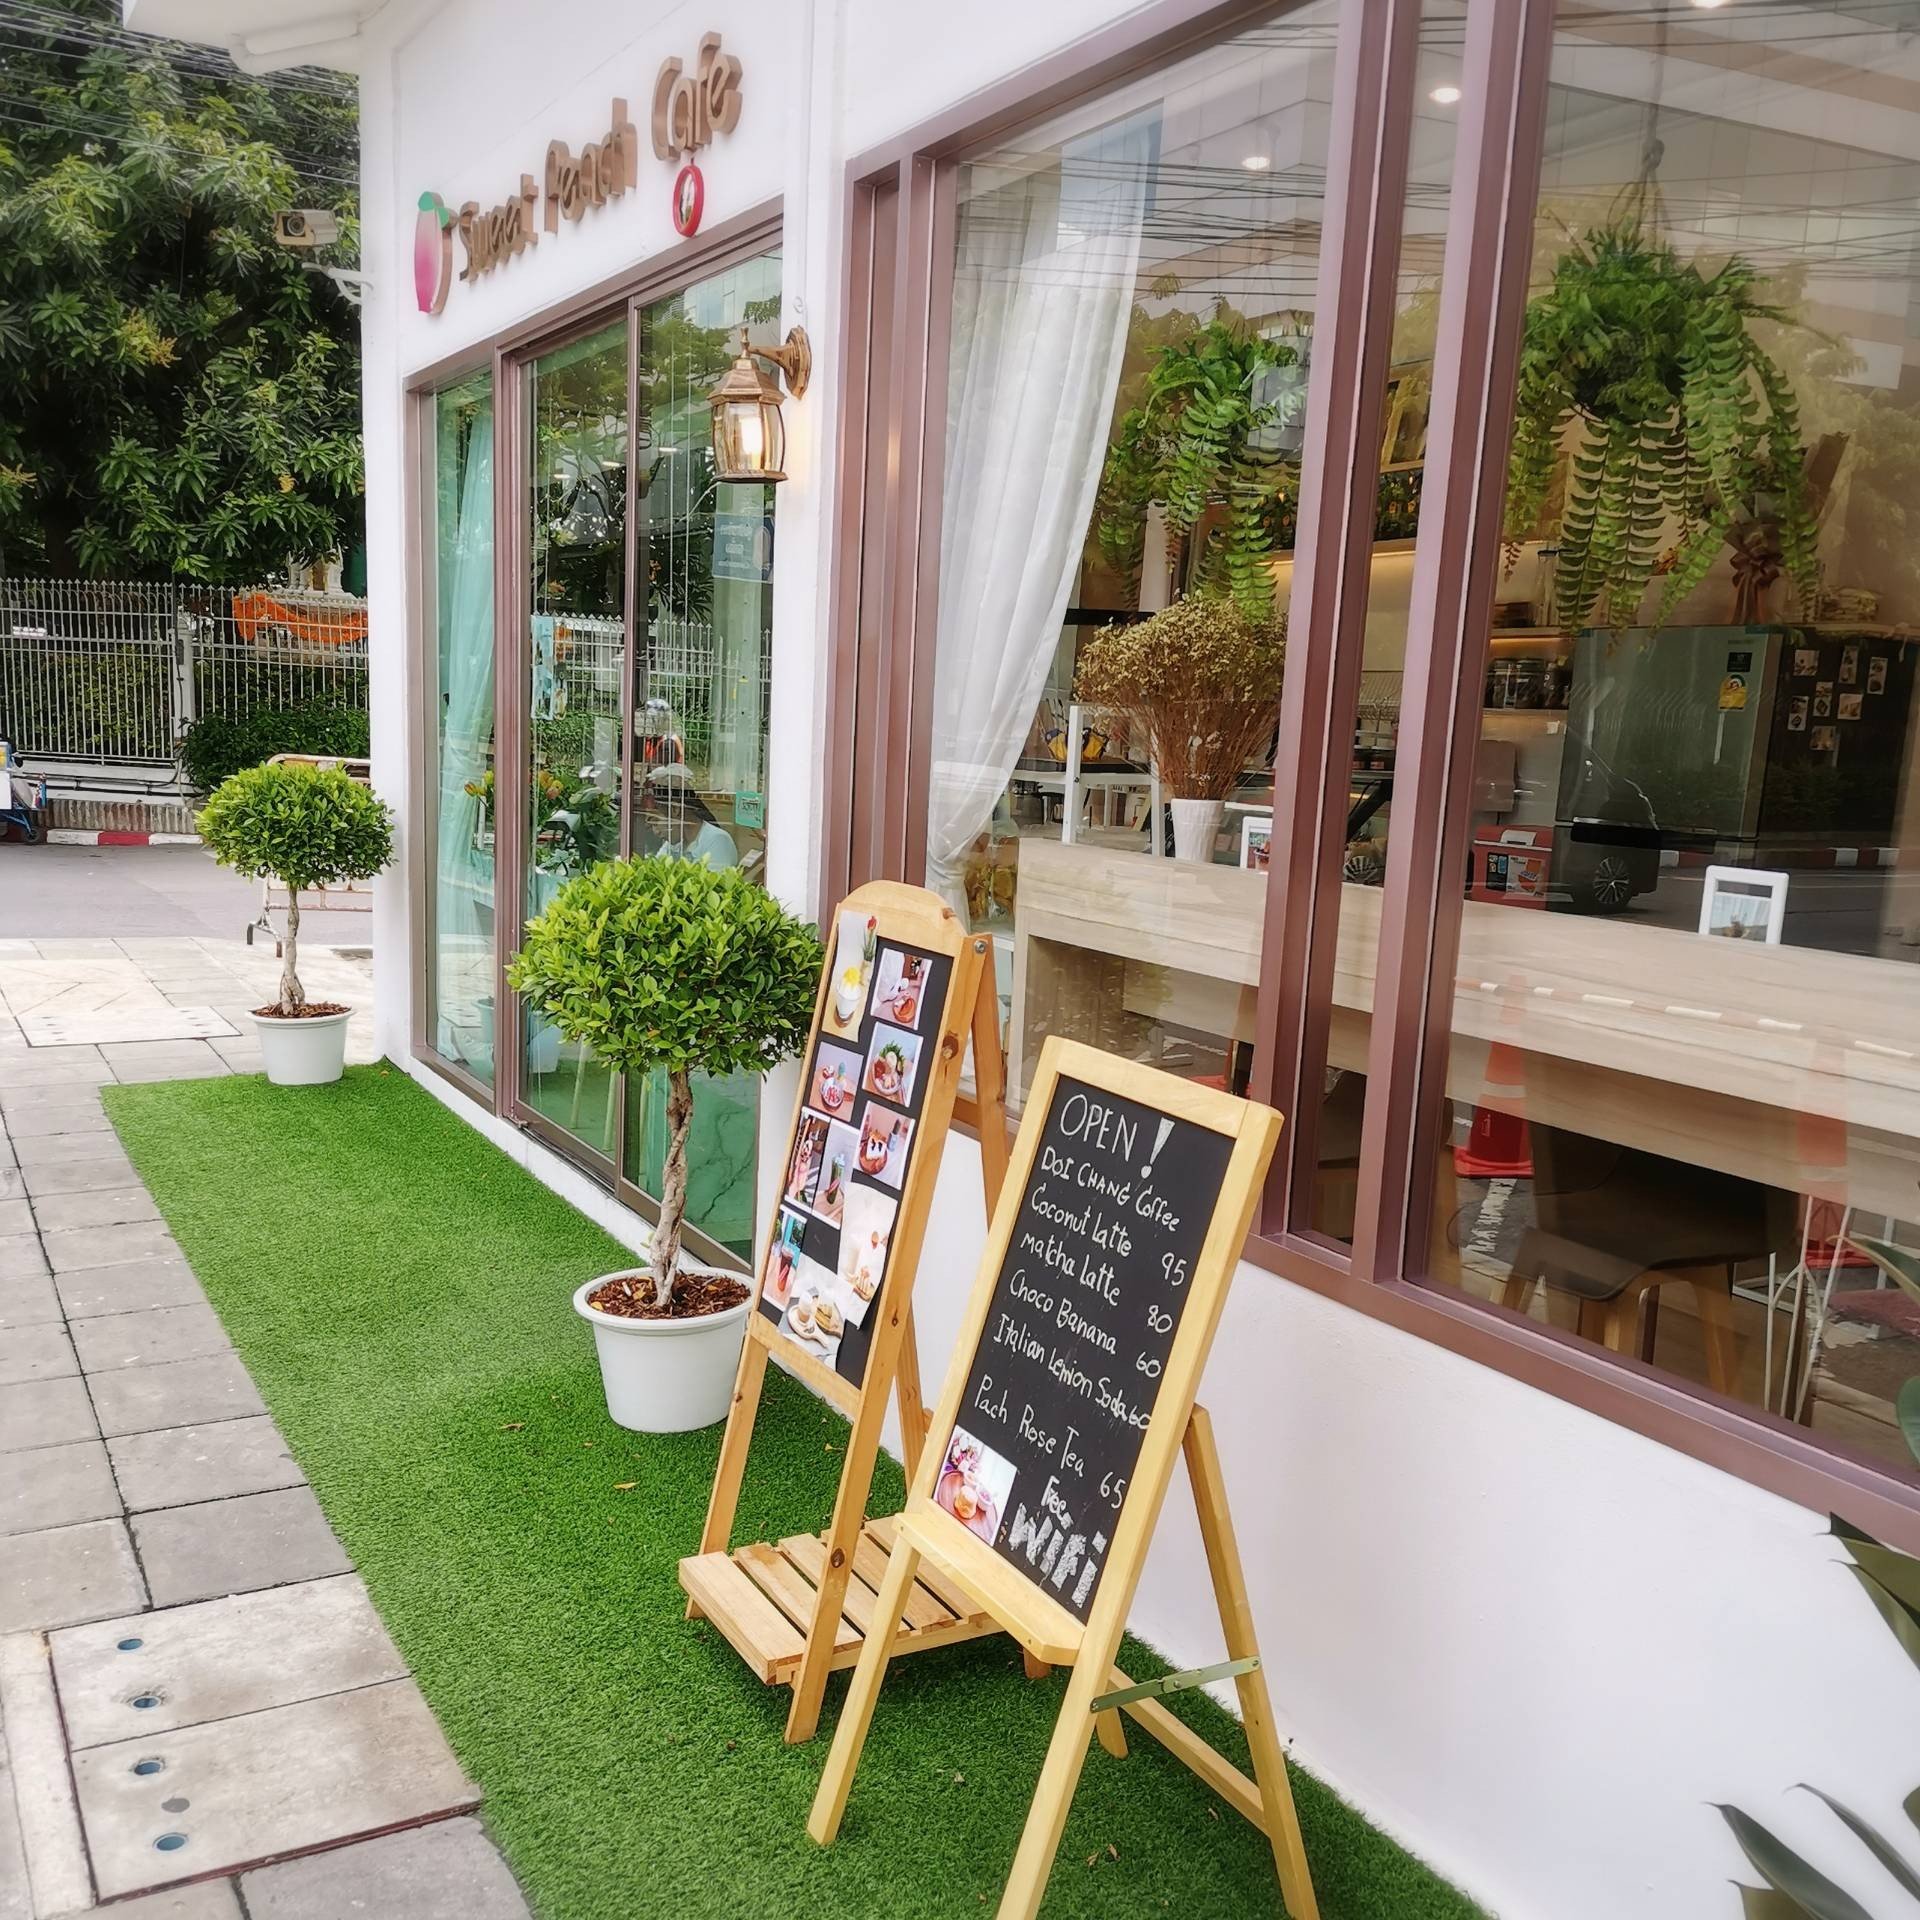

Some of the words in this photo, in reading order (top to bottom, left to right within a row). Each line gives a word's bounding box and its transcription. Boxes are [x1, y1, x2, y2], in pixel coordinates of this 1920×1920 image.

[459, 171, 539, 280] Sweet
[544, 97, 638, 235] Peach
[651, 30, 743, 161] Cafe
[1031, 1182, 1091, 1235] Coconut
[1092, 1211, 1132, 1257] Latte
[1161, 1252, 1187, 1287] 95
[1077, 1162, 1131, 1206] CHANG
[1135, 1184, 1180, 1232] Coffee
[1009, 1269, 1054, 1313] Choco
[1056, 1297, 1117, 1355] Banana
[1135, 1351, 1161, 1378] 60
[1020, 1232, 1075, 1277] Matcha
[1147, 1304, 1173, 1334] 80
[993, 1313, 1045, 1364] Italian
[1095, 1377, 1128, 1422] Soda
[1128, 1405, 1152, 1430] 60
[974, 1374, 1008, 1424] Pach
[1019, 1404, 1057, 1454] Rose
[1060, 1425, 1084, 1478] Tea
[1100, 1471, 1127, 1509] 65
